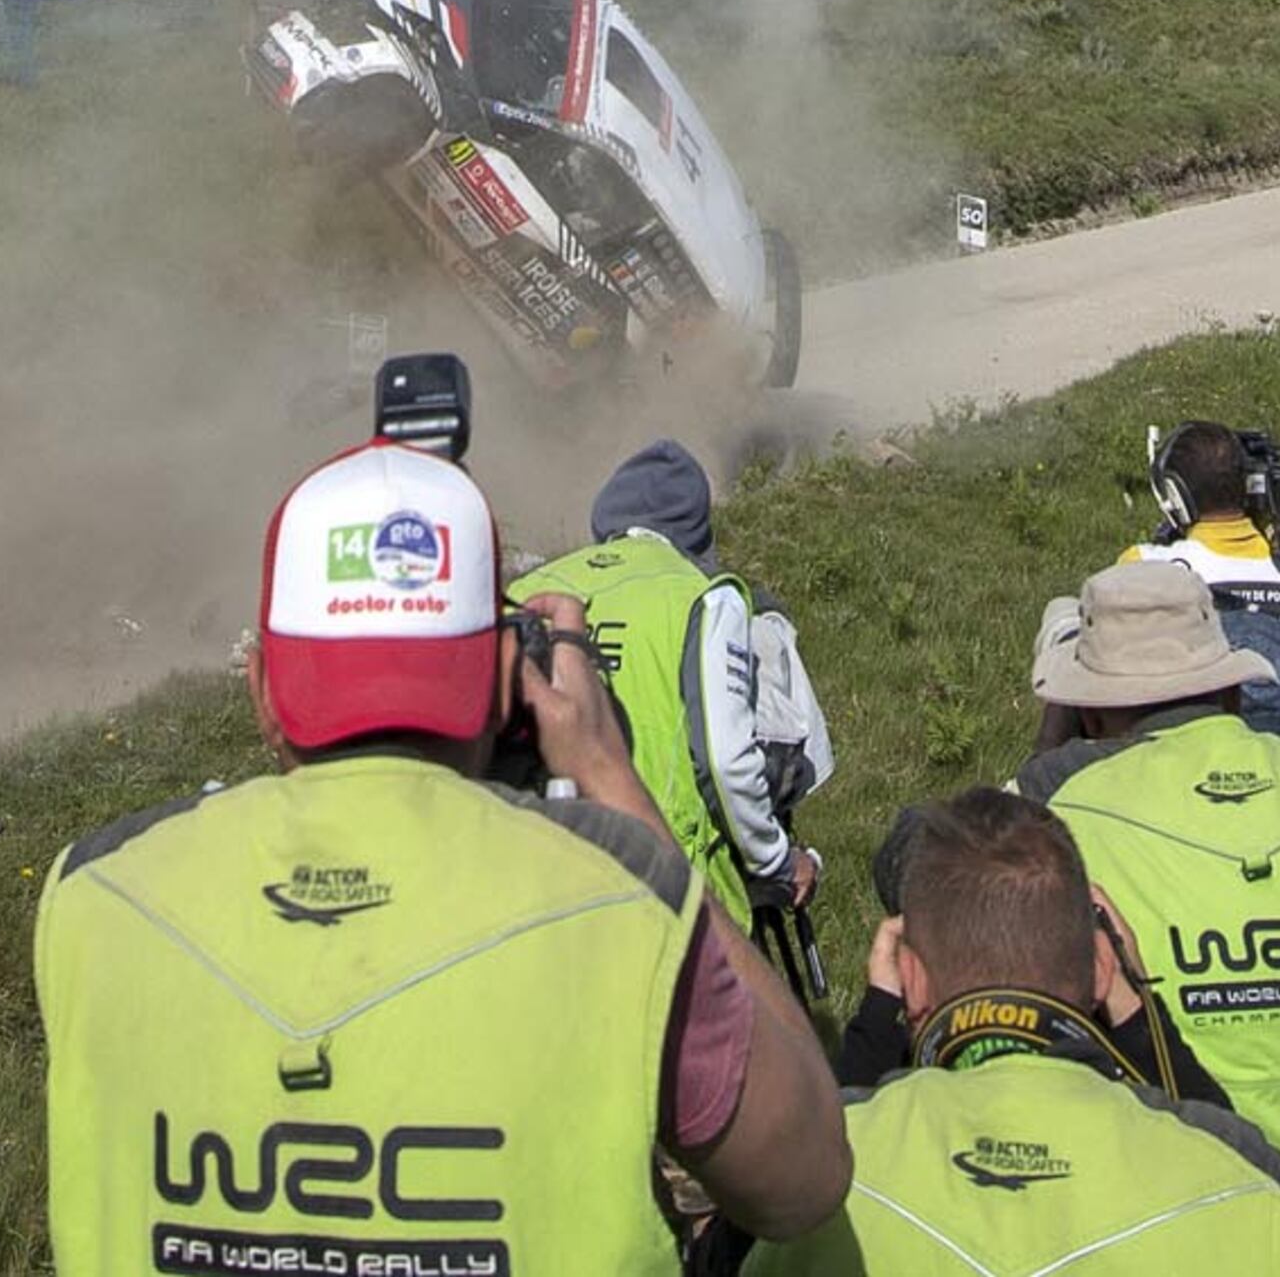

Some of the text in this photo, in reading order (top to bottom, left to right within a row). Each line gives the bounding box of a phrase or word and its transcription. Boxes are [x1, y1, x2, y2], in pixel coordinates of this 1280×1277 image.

[961, 207, 982, 225] 50
[521, 256, 580, 315] IROISE
[331, 529, 366, 560] 14
[327, 594, 447, 615] doctor auto
[1186, 989, 1221, 1007] FIA
[950, 998, 1040, 1036] Nikon
[154, 1111, 505, 1222] WRC
[163, 1236, 498, 1277] FIA WORLD RALLY
